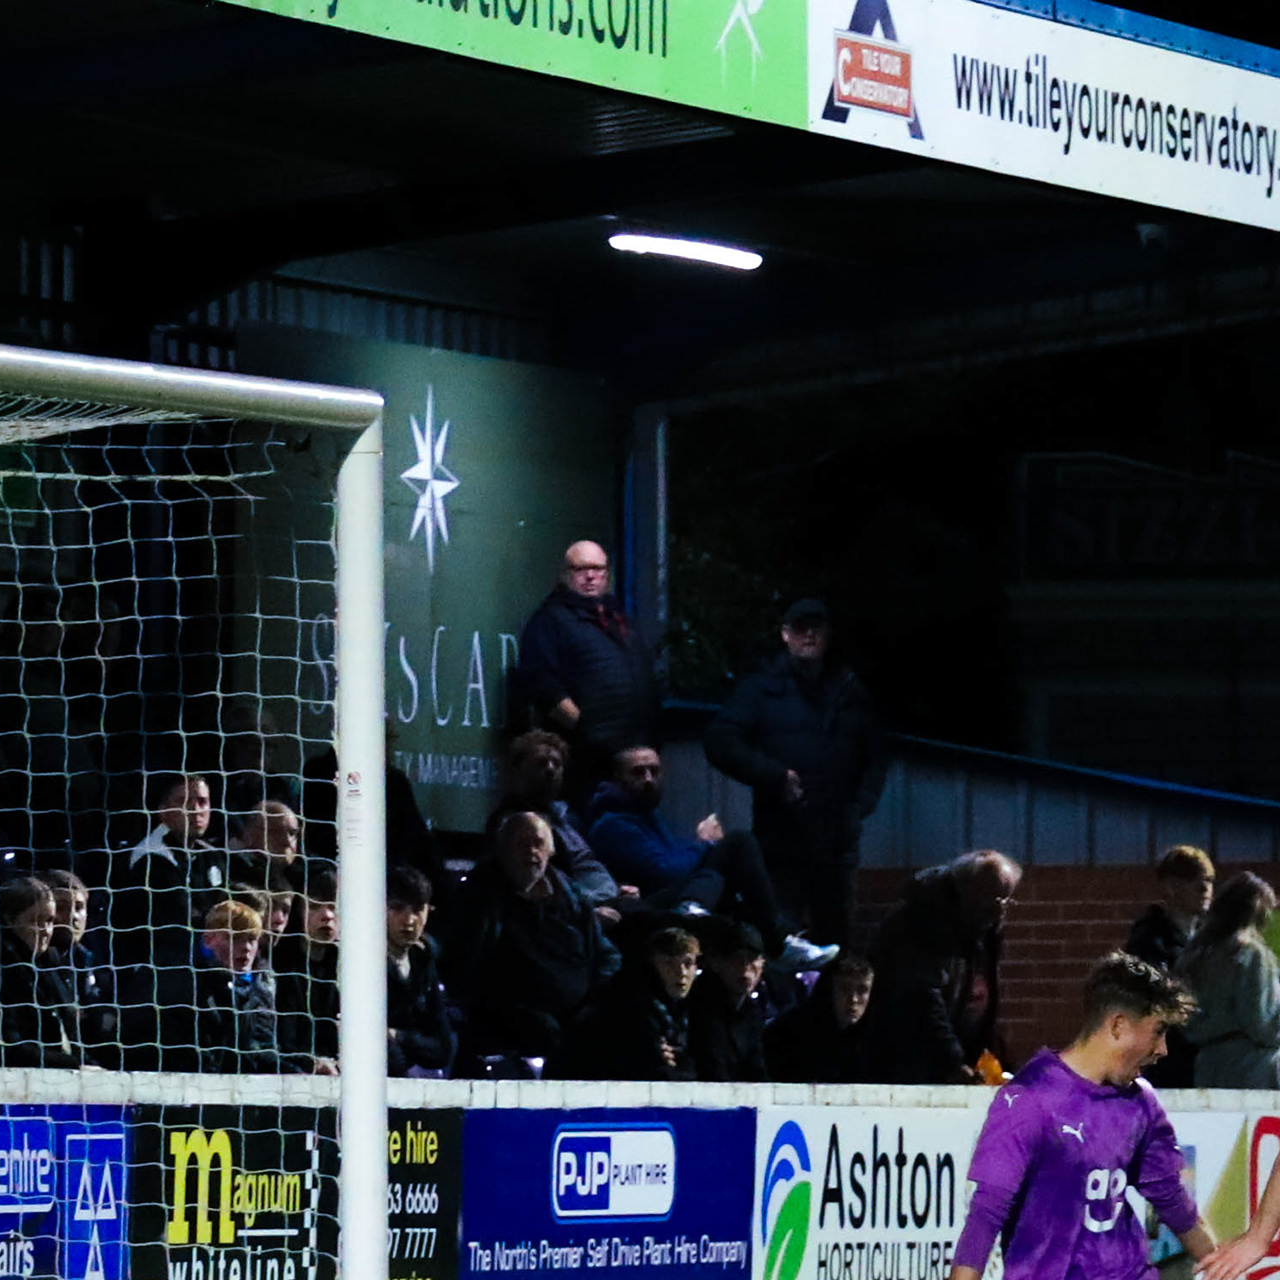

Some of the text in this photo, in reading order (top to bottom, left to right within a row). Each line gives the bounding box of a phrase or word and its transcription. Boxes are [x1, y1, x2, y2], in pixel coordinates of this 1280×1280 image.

[406, 1120, 438, 1164] hire
[558, 1151, 667, 1196] PJP PLANT HIRE
[818, 1123, 955, 1230] Ashton
[405, 1183, 439, 1214] 6666
[405, 1228, 437, 1259] 7777
[469, 1234, 747, 1272] The North's Premier Self Drive Plant Hire Company
